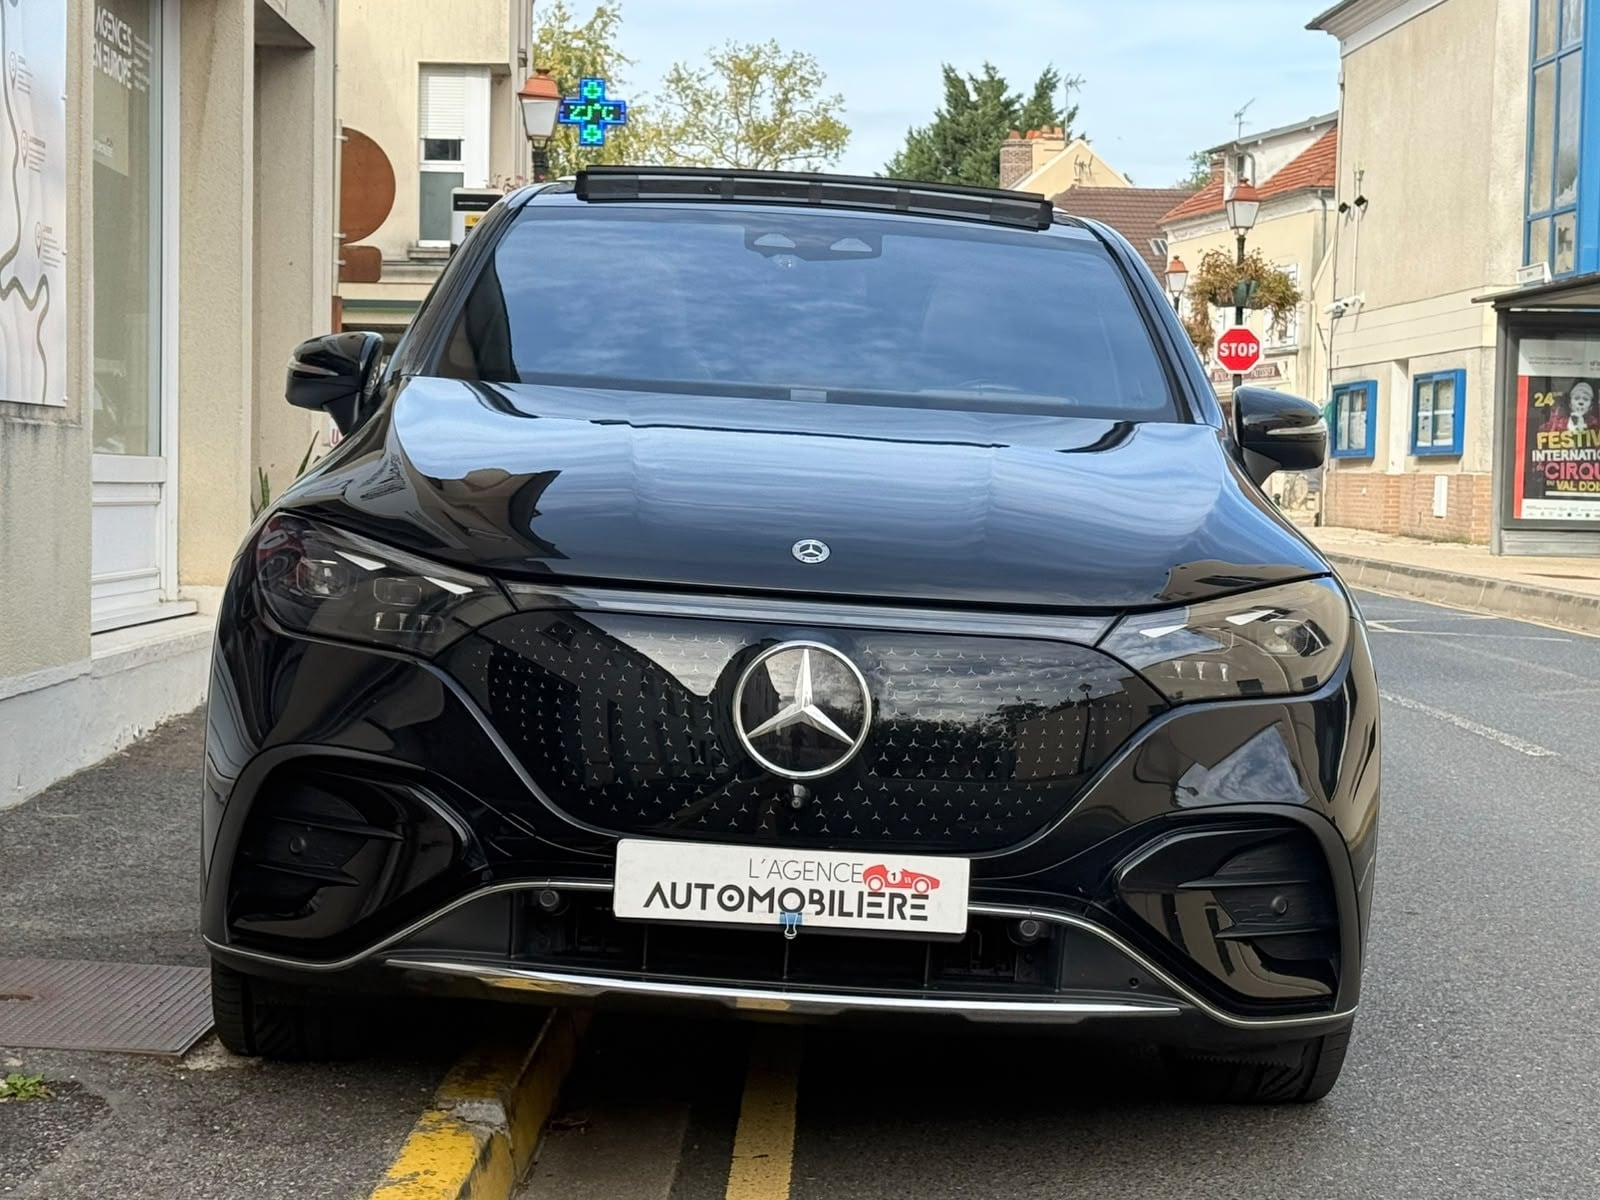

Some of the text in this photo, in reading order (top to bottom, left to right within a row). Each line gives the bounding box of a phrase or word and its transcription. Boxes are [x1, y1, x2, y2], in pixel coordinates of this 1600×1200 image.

[95, 6, 132, 55] AGENCES
[103, 43, 132, 90] EUROPE
[1219, 342, 1258, 357] STOP
[1534, 392, 1555, 408] 24
[1556, 480, 1577, 491] VAL
